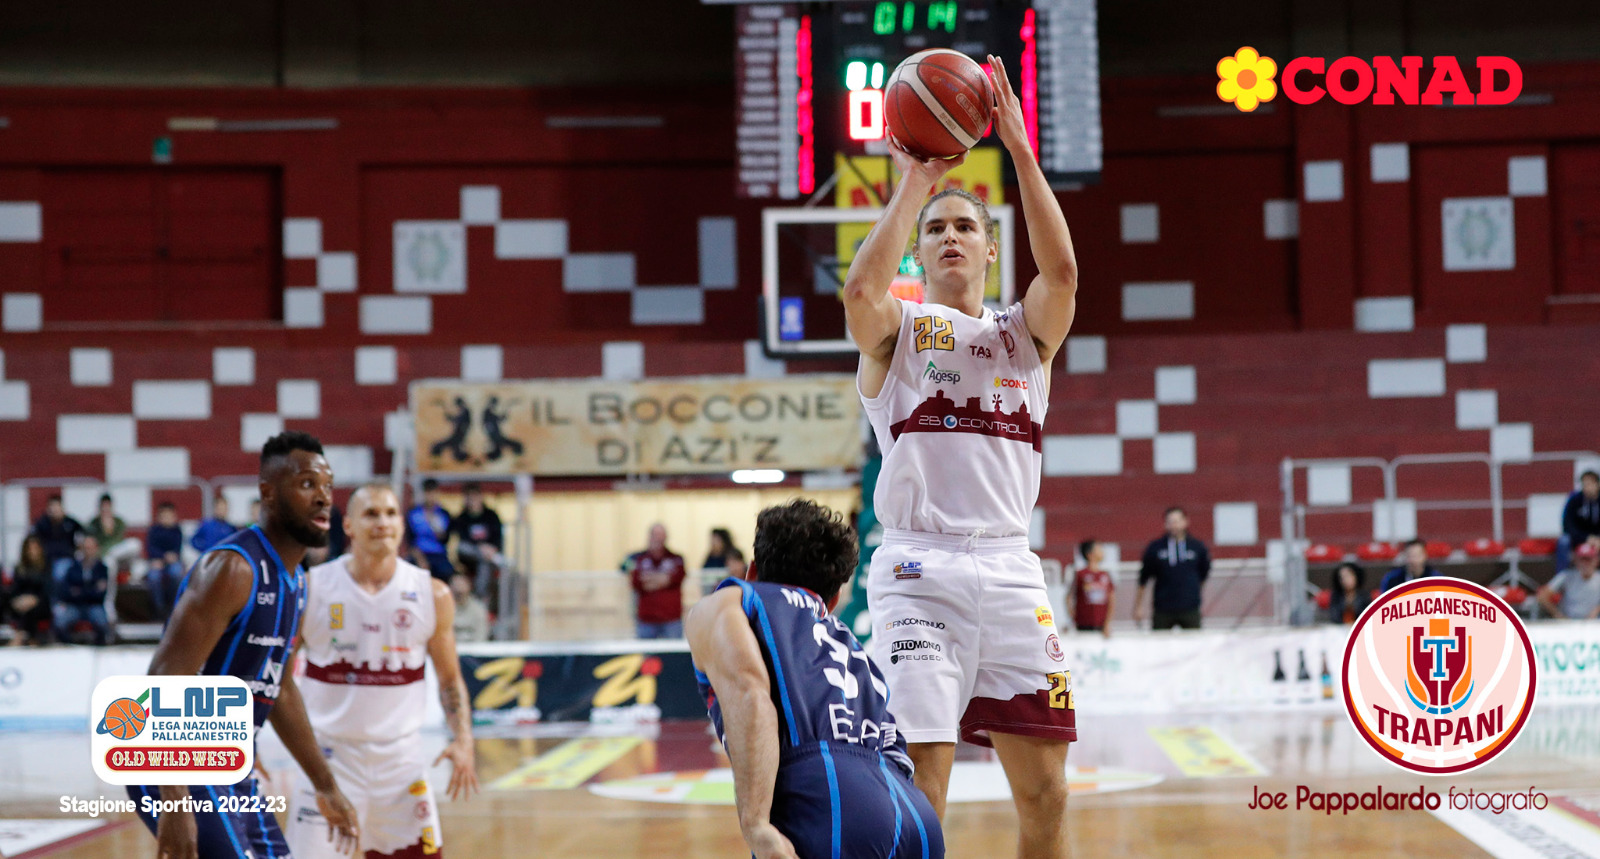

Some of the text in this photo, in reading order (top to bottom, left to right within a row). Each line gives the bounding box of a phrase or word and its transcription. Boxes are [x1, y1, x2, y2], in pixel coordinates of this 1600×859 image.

[914, 316, 954, 353] 22
[929, 370, 961, 384] Agesp
[531, 393, 845, 425] IL BOCCONE
[918, 415, 1028, 434] 2B CONTROL
[597, 435, 781, 466] DI AZI'Z
[260, 559, 270, 585] 1
[329, 603, 343, 629] 9
